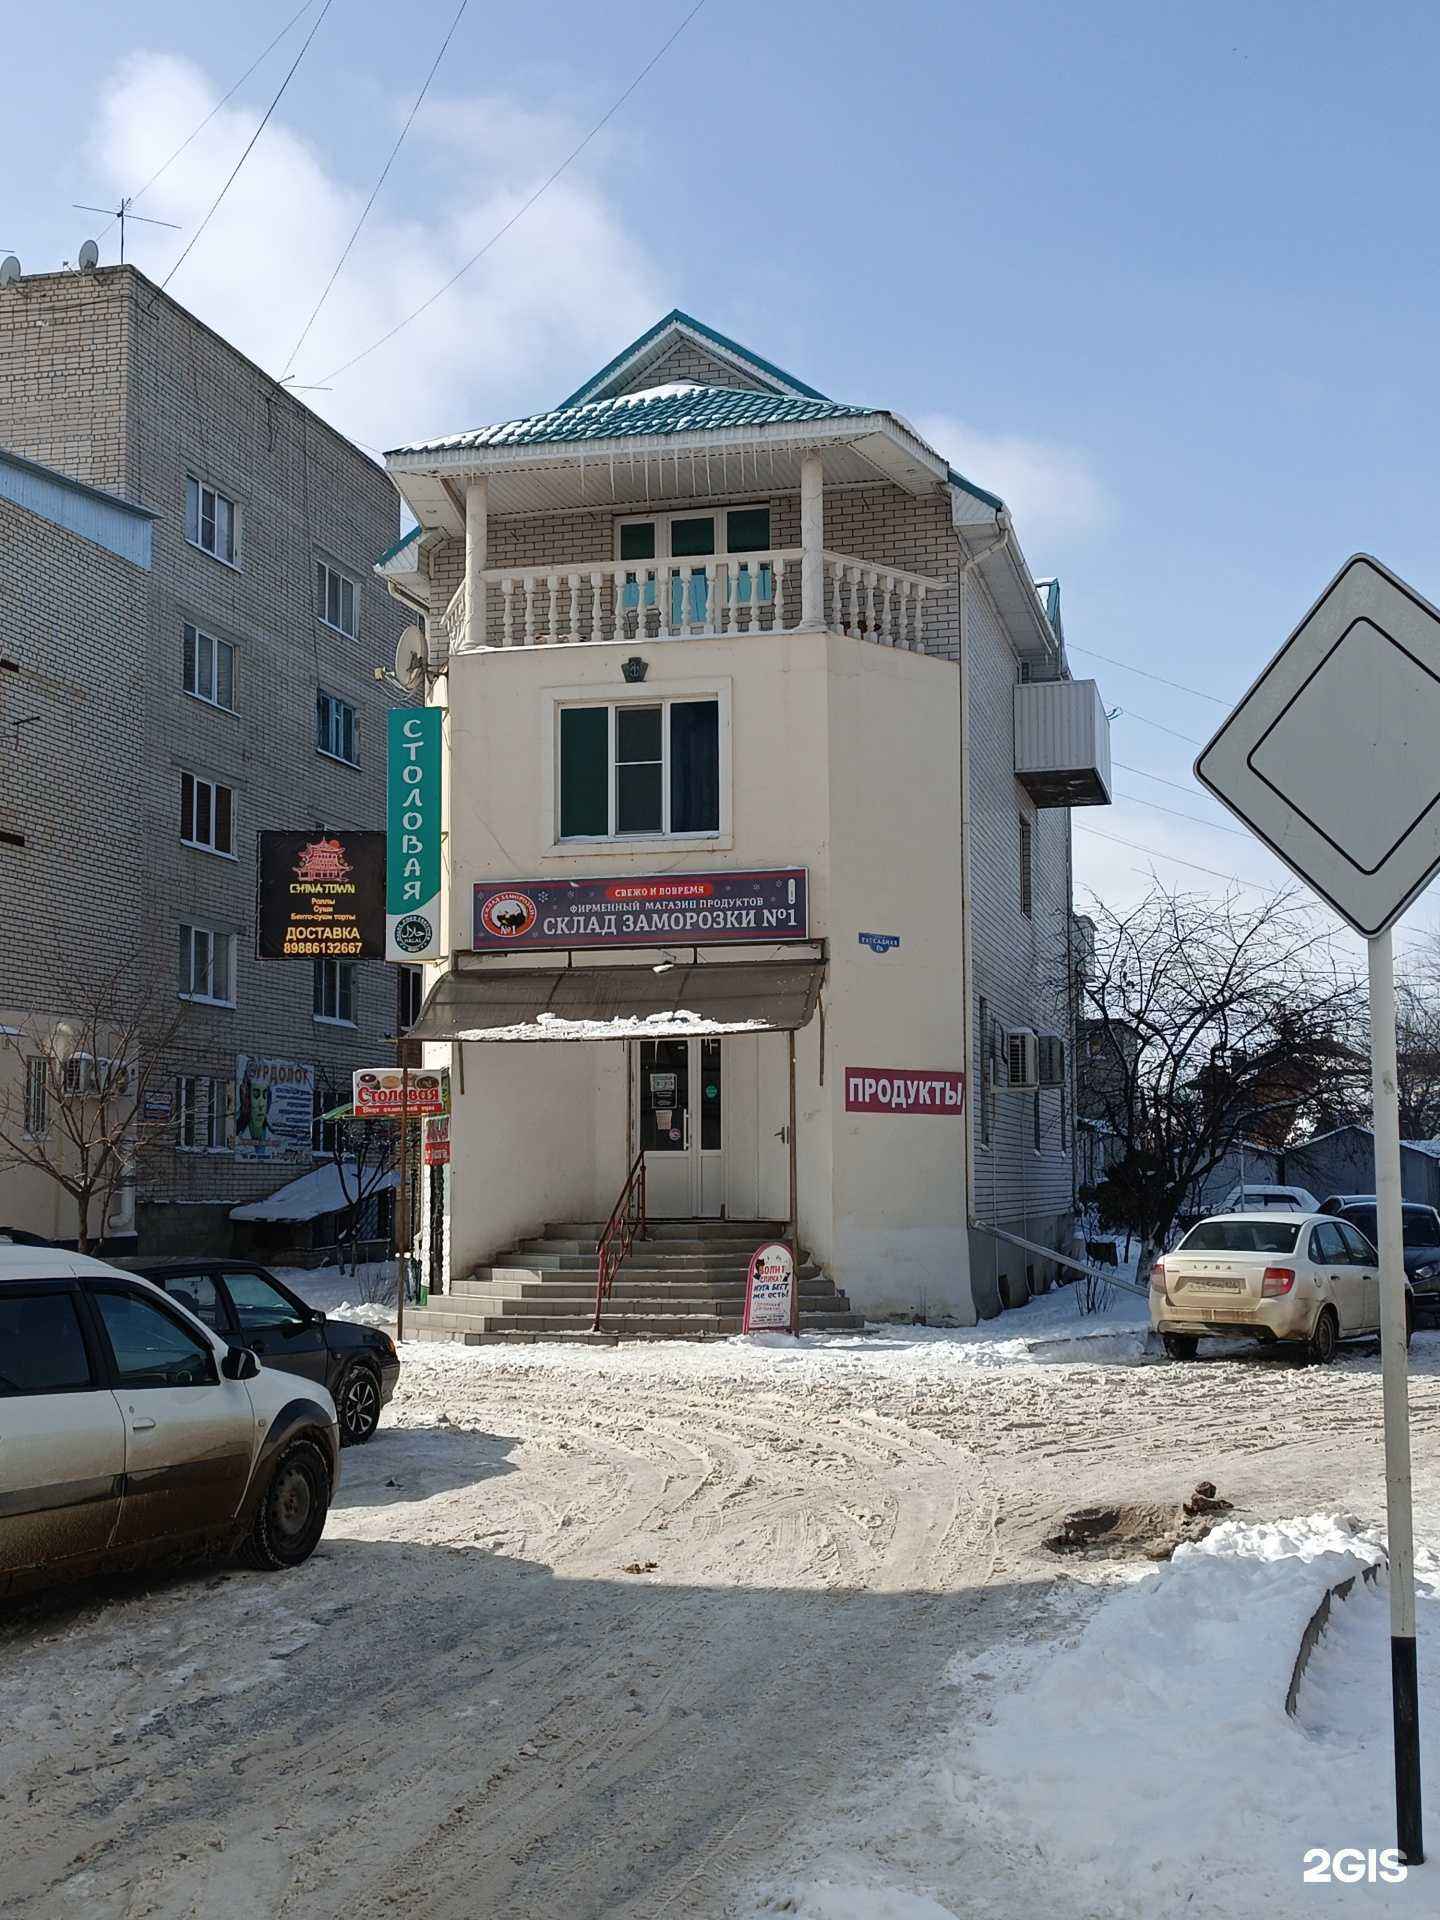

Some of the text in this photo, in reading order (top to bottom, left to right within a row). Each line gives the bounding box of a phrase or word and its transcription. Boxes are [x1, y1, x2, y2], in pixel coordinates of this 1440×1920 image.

[402, 719, 424, 900] СТОЛОВАЯ
[614, 885, 705, 898] СВЕЖО И ВОВРЕМЯ
[569, 897, 764, 914] ФИРМЕННЫЙ МАГАЗИН ПРОДУКТОВ
[286, 926, 361, 941] ДОСТАВКА
[543, 915, 617, 936] СКЛАД
[622, 909, 758, 933] ЗАМОРОЗКИ
[848, 1077, 963, 1109] ПРОДУКТЫ
